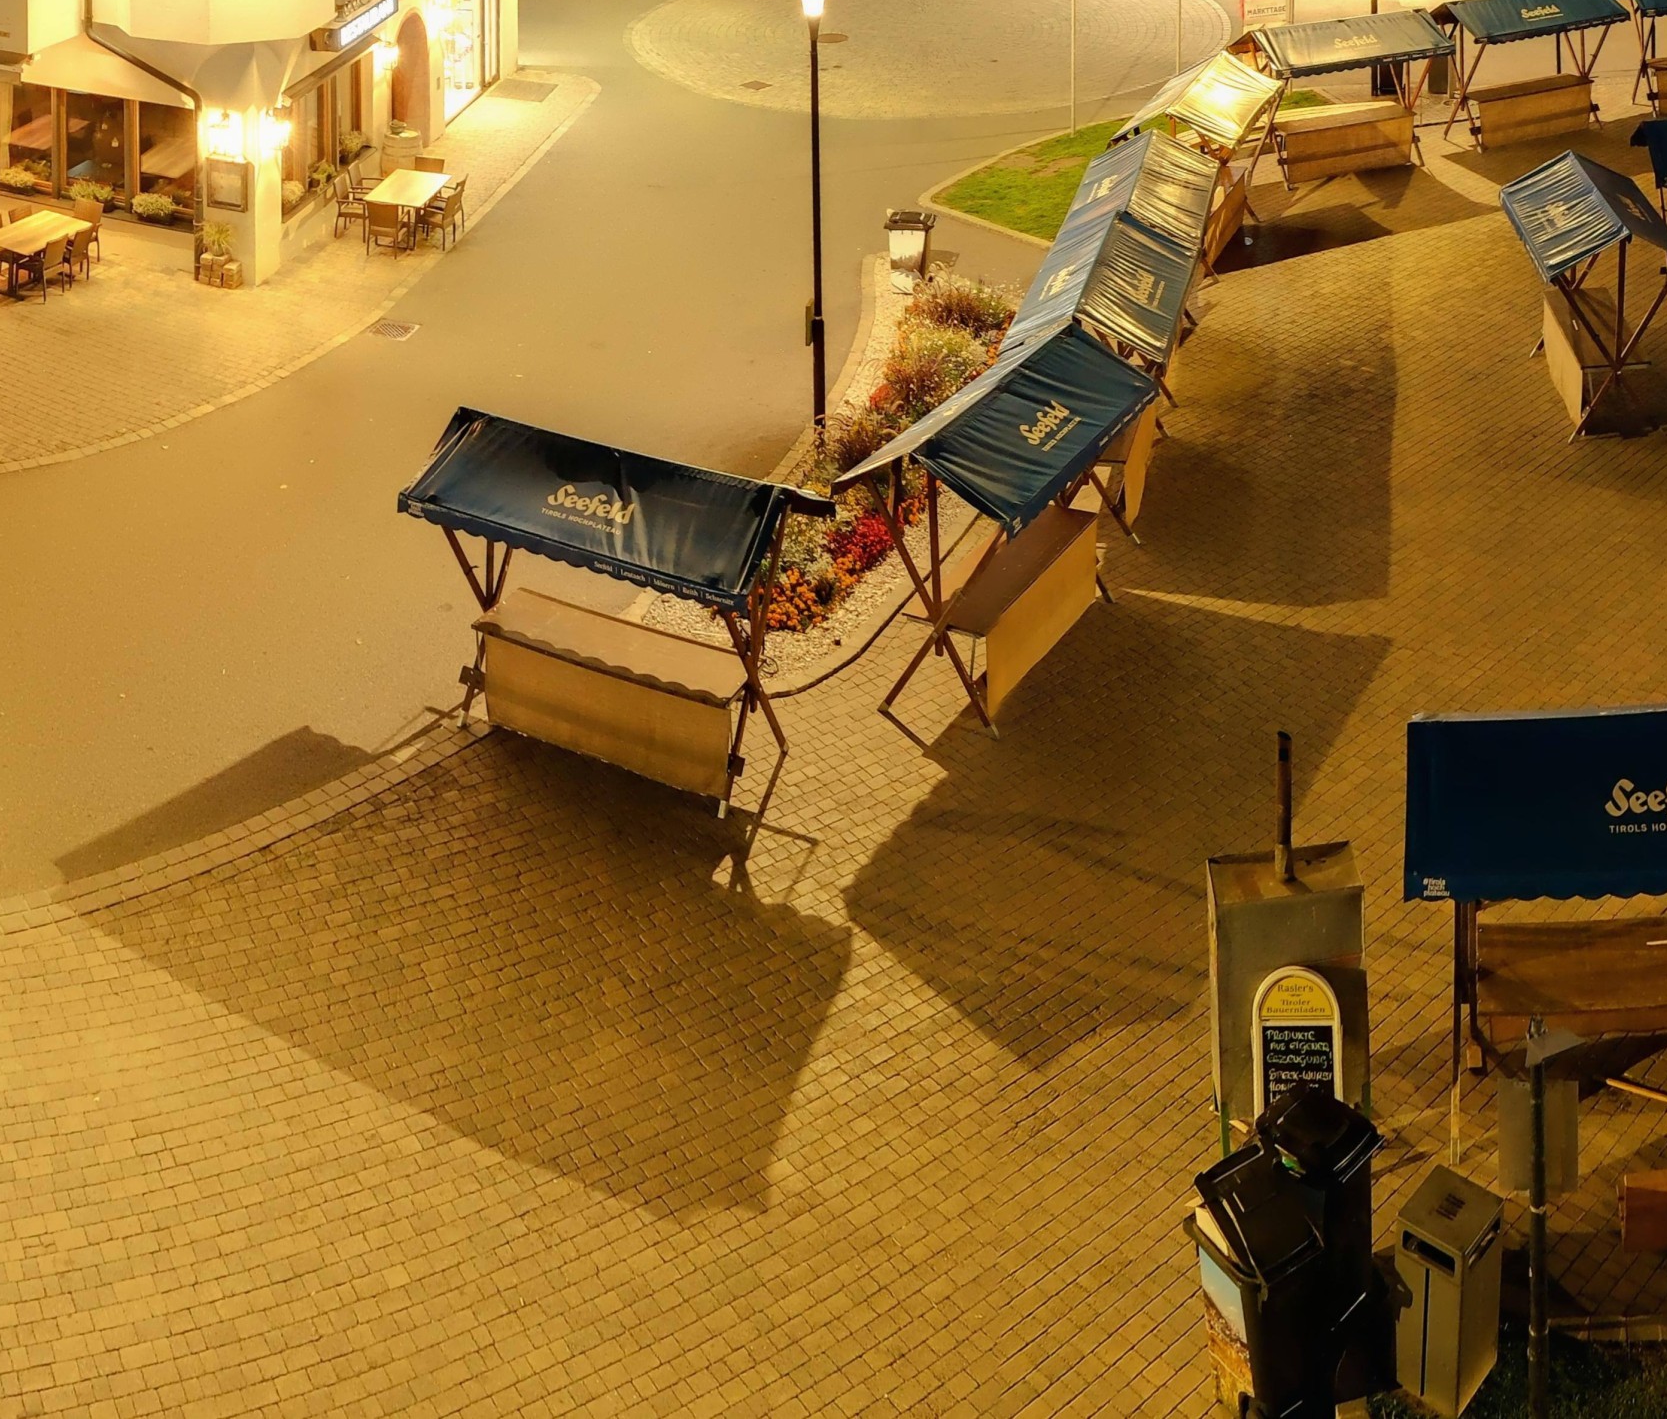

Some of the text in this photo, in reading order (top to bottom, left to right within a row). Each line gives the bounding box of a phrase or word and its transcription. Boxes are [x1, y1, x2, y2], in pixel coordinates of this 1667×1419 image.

[1247, 5, 1287, 17] MARKTTAGE
[1521, 4, 1560, 20] Seefeld
[1335, 34, 1379, 49] Seefeld
[1019, 399, 1070, 447] Seefeld
[547, 484, 636, 525] Seefeld
[540, 507, 622, 536] TIROLS HOCHPLATEAU
[1609, 823, 1648, 834] TIROLS
[1277, 983, 1314, 993] Rasler's
[1282, 998, 1311, 1006] Tiroler
[1266, 1005, 1326, 1014] Bauernladen
